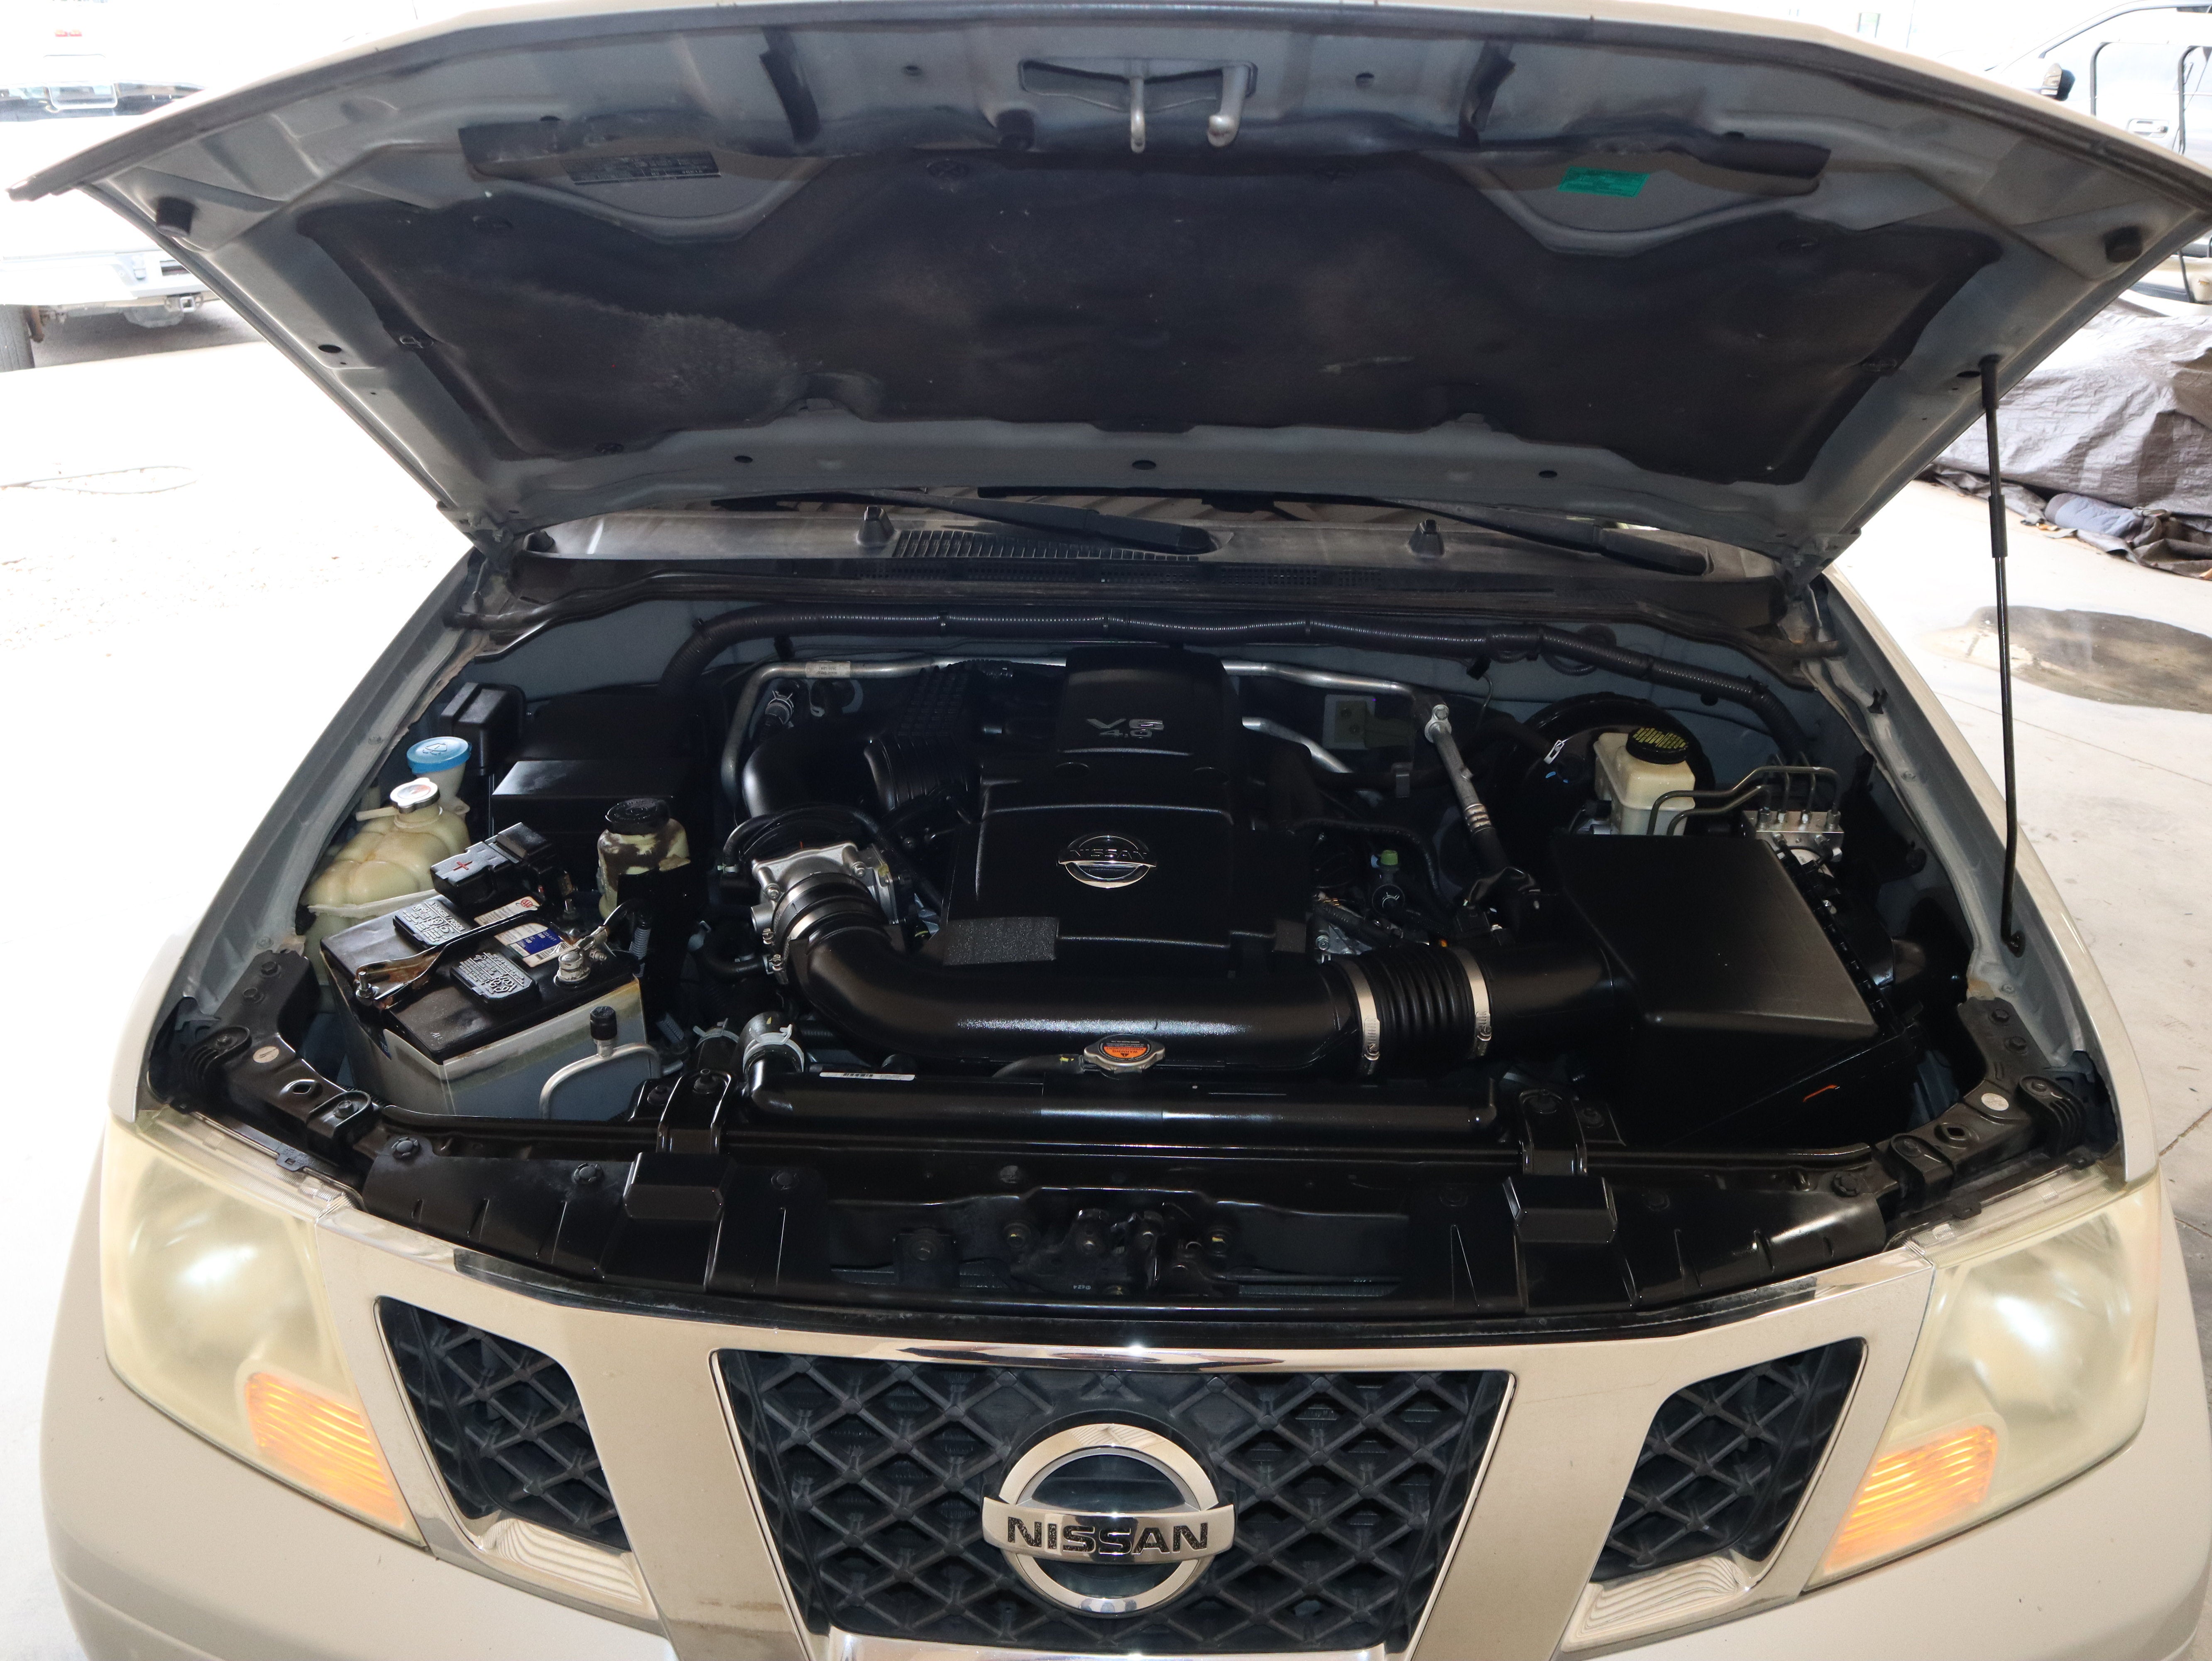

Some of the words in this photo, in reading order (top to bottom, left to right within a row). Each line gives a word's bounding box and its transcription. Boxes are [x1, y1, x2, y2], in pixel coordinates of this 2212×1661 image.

[1086, 718, 1165, 731] V6
[1099, 729, 1153, 738] 4.0
[1069, 849, 1148, 860] NISSAN
[1007, 1516, 1209, 1555] NISSAN
